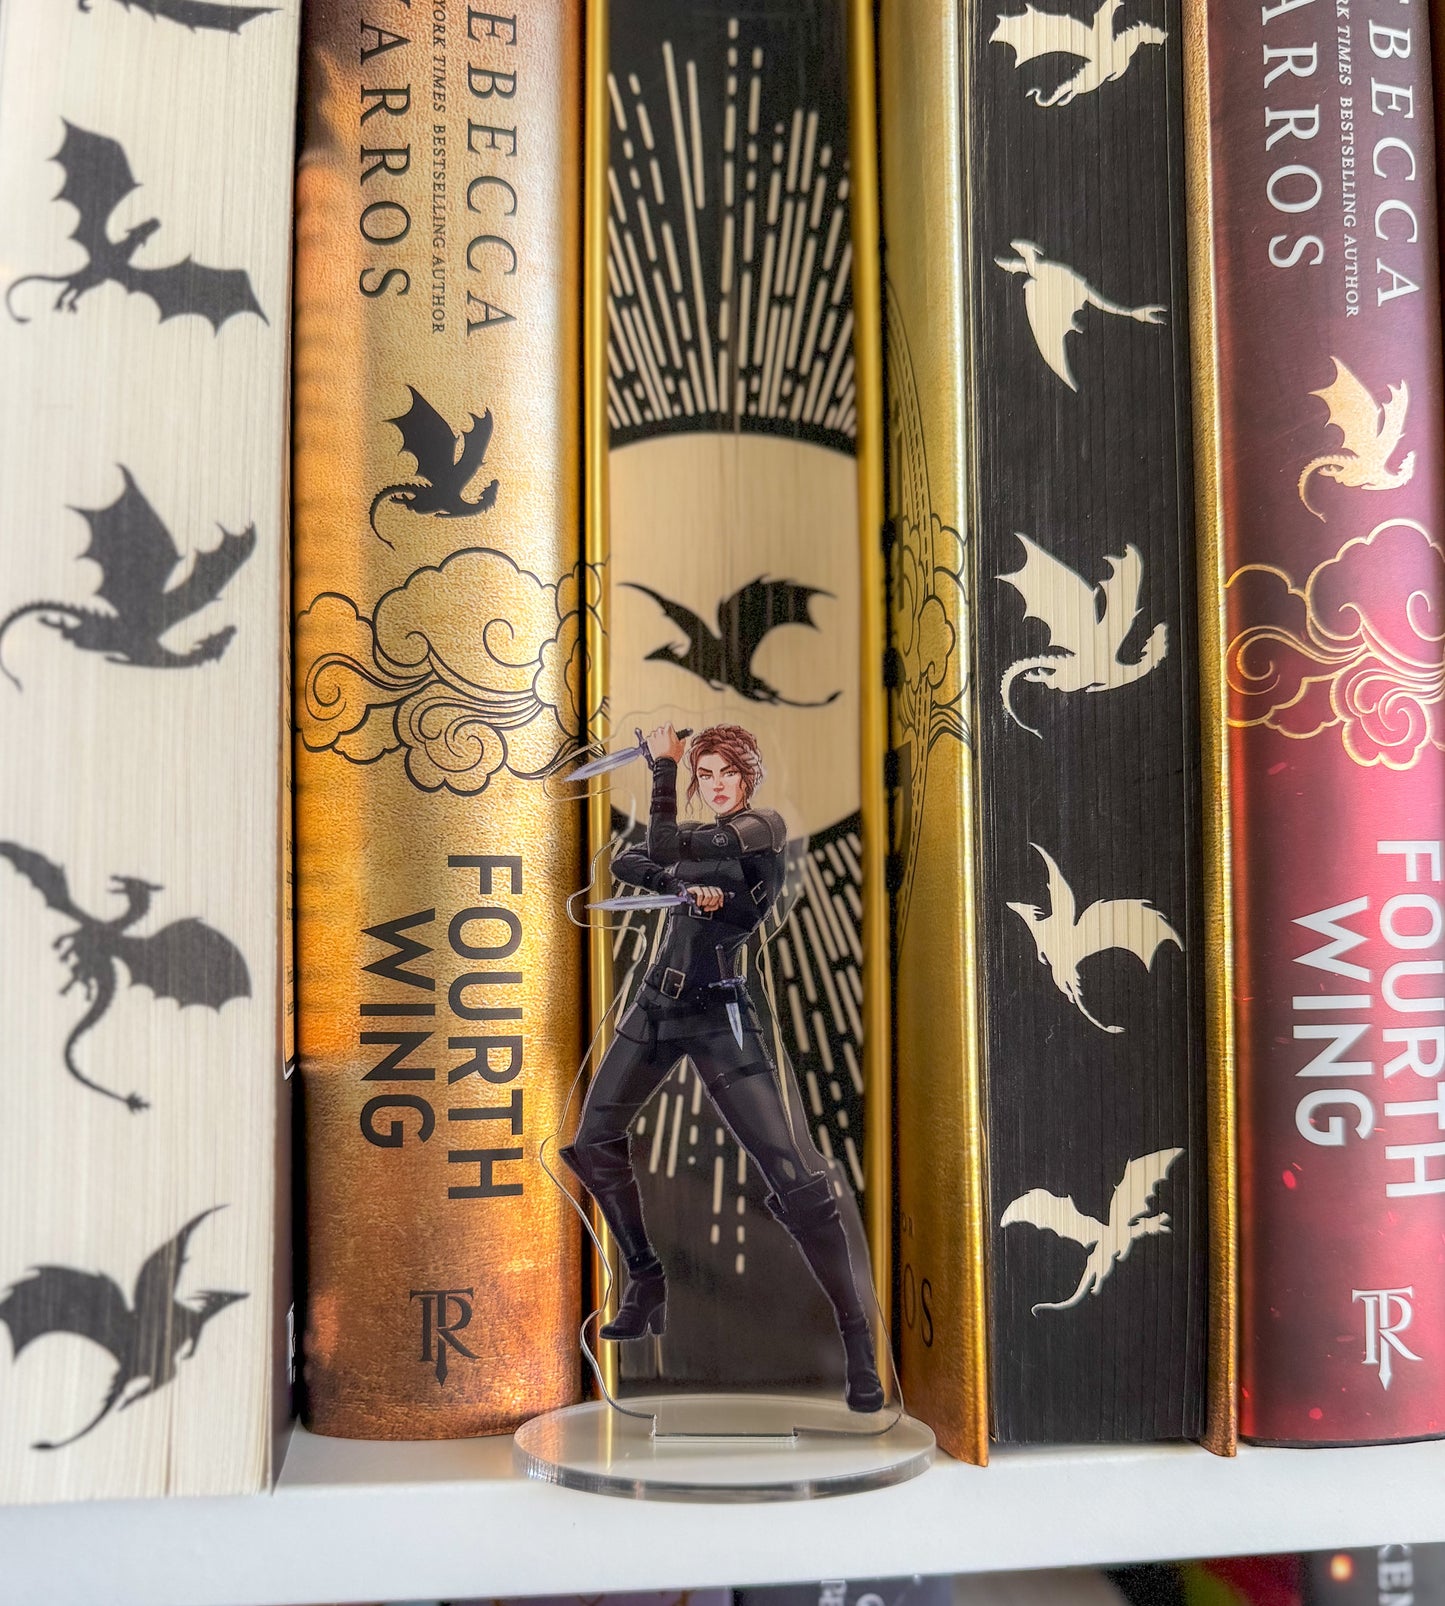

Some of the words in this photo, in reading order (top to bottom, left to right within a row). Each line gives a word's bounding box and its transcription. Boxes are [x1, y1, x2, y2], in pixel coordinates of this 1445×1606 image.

[359, 0, 412, 298] ARROS
[432, 56, 446, 113] TIMES
[467, 5, 518, 337] EBECCA
[1337, 25, 1352, 86] TIMES
[1339, 97, 1358, 228] BESTSELLING
[1369, 0, 1420, 307] BECCA
[432, 125, 446, 248] BESTSELLING
[432, 255, 446, 334] AUTHOR
[1344, 233, 1360, 318] AUTHOR
[359, 907, 436, 1148] WING
[447, 854, 523, 1200] FOURTH
[1291, 895, 1376, 1147] WING
[1376, 840, 1445, 1199] FOURTH
